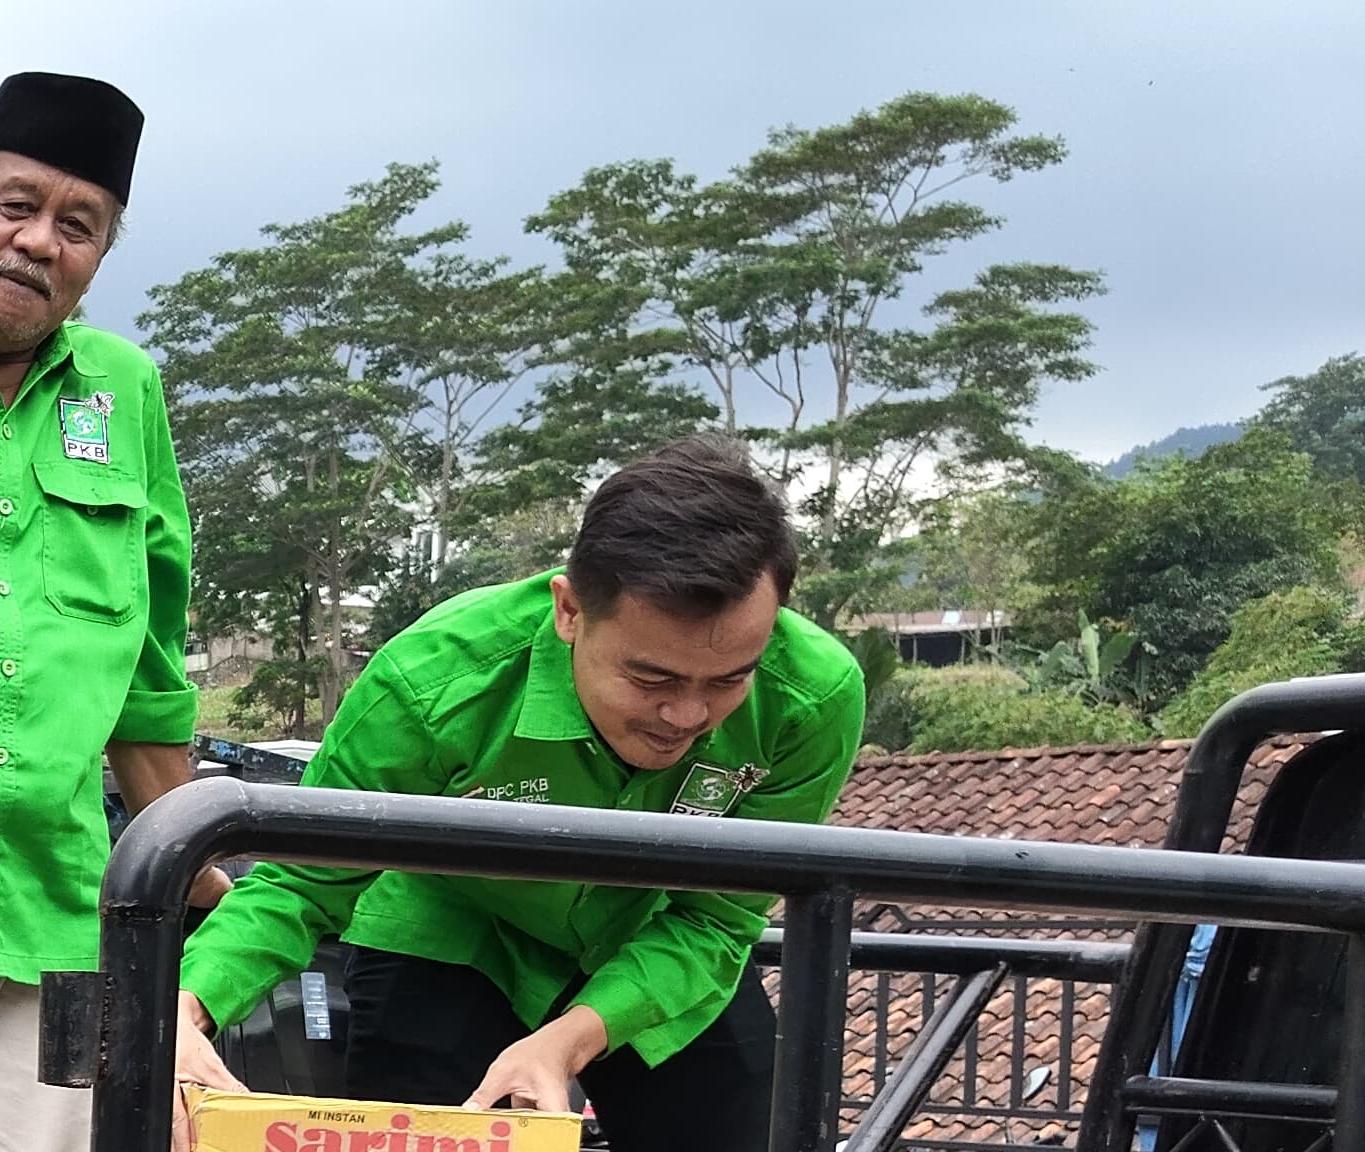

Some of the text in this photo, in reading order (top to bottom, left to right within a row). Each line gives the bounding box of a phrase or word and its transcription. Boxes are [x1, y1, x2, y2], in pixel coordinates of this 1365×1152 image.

[67, 442, 105, 459] PKB
[487, 778, 550, 800] DPC PKB
[308, 1110, 365, 1124] MI INSTAN
